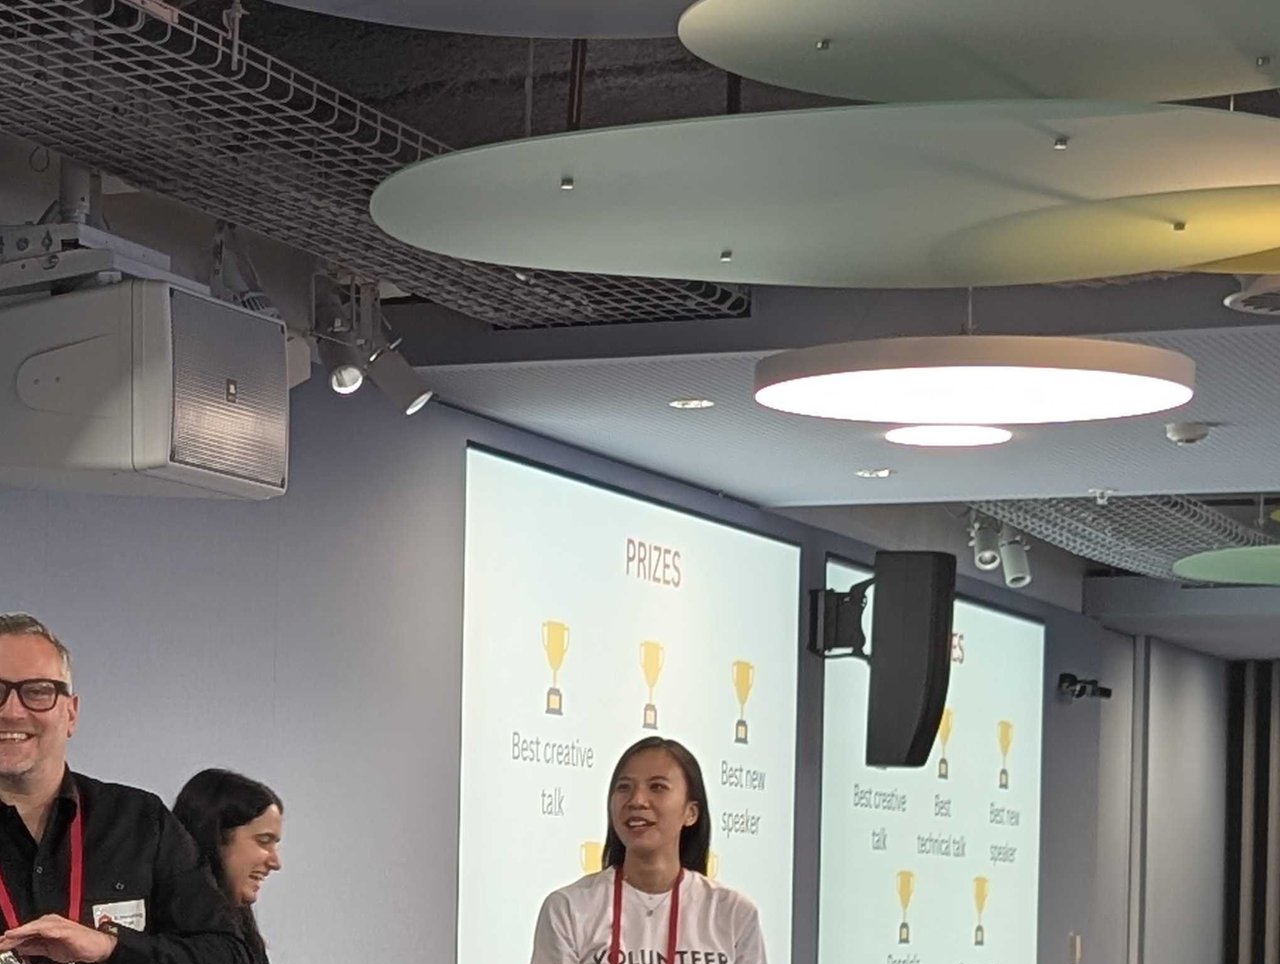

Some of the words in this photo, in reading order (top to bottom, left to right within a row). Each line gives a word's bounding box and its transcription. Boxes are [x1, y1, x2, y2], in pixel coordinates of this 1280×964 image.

[625, 537, 681, 588] PRIZES
[512, 731, 541, 762] Best
[543, 738, 594, 768] creative
[721, 759, 743, 788] Best
[745, 769, 766, 790] new
[541, 786, 565, 816] talk
[853, 783, 873, 808] Best
[874, 787, 907, 812] creative
[934, 793, 952, 817] Best
[721, 810, 762, 838] speaker
[989, 801, 1005, 825] Best
[871, 826, 888, 850] talk
